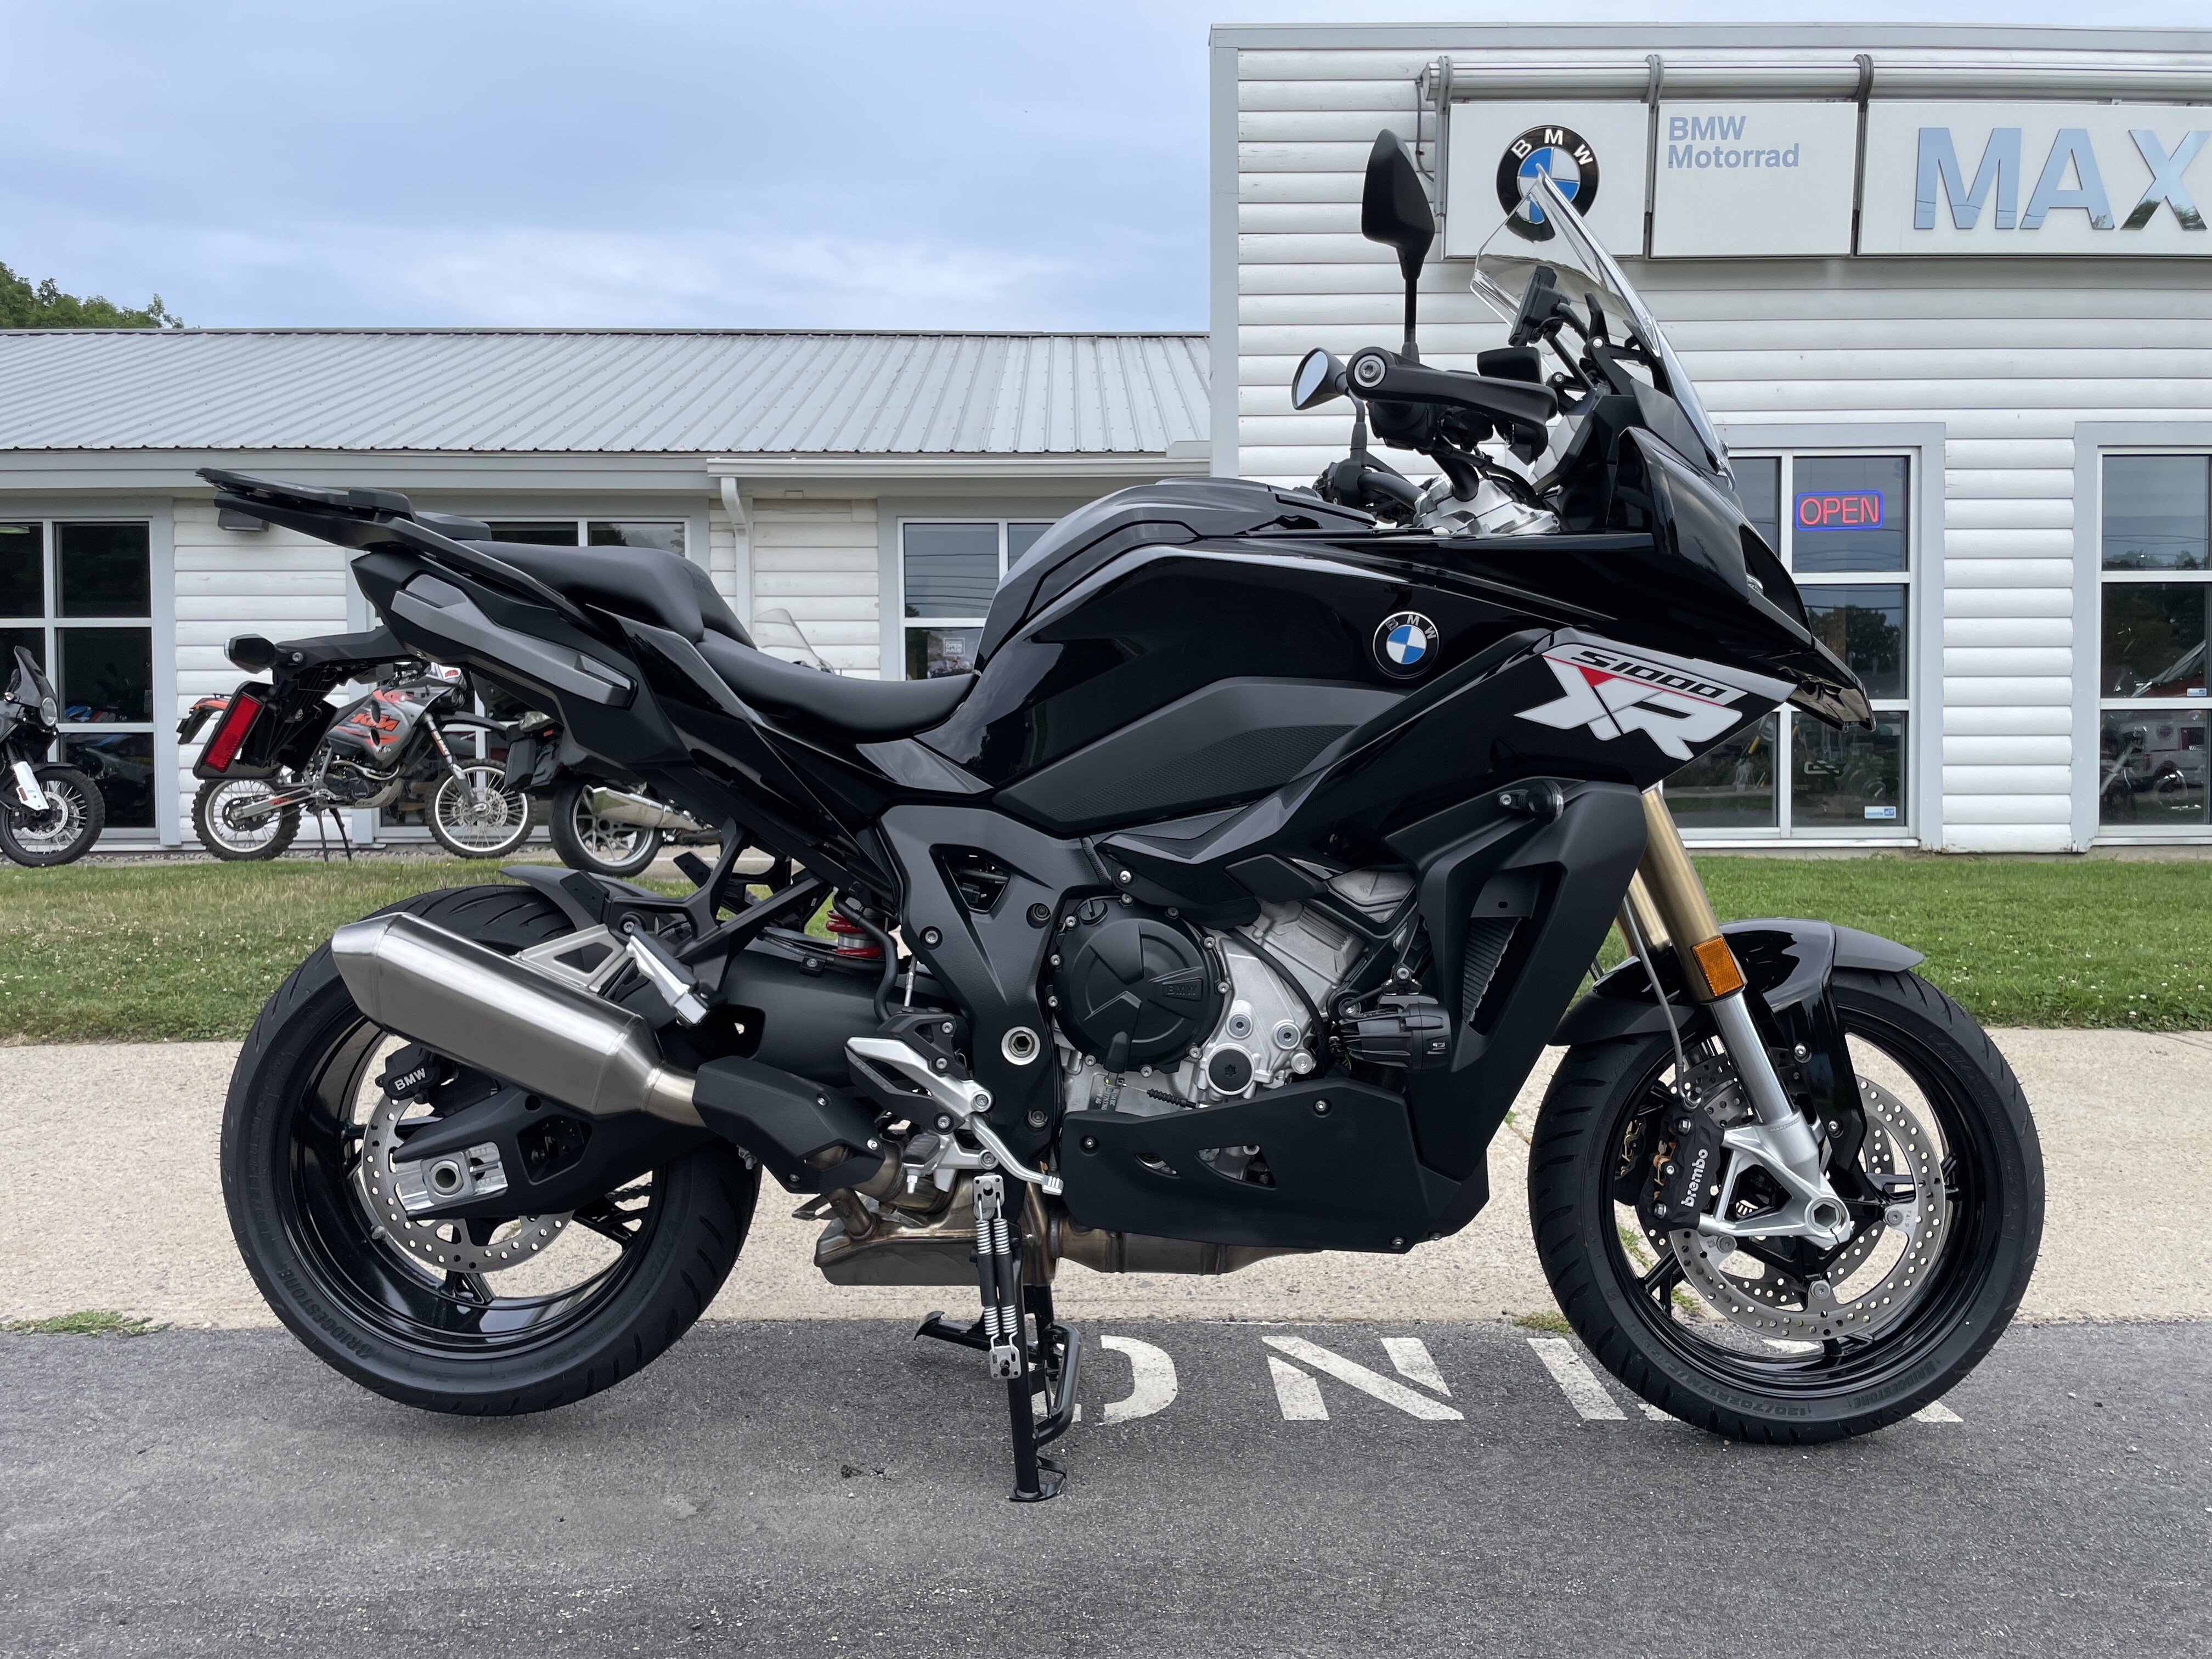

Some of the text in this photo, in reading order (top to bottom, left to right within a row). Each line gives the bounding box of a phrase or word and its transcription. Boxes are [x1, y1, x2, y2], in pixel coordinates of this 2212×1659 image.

[1510, 128, 1593, 165] BMW
[1668, 116, 1746, 141] BMW
[1668, 143, 1799, 168] Motorrad
[1914, 127, 2211, 230] MAX
[1799, 496, 1878, 525] OPEN
[1385, 614, 1437, 640] BMW
[1571, 651, 1728, 698] S1000
[1514, 656, 1743, 761] XR
[1166, 985, 1197, 996] BMW
[394, 1068, 426, 1091] BMW
[1681, 1149, 1708, 1207] brembo
[278, 1269, 374, 1360] BRIDGESTONE
[1853, 1360, 1937, 1408] BRIDGESTONE
